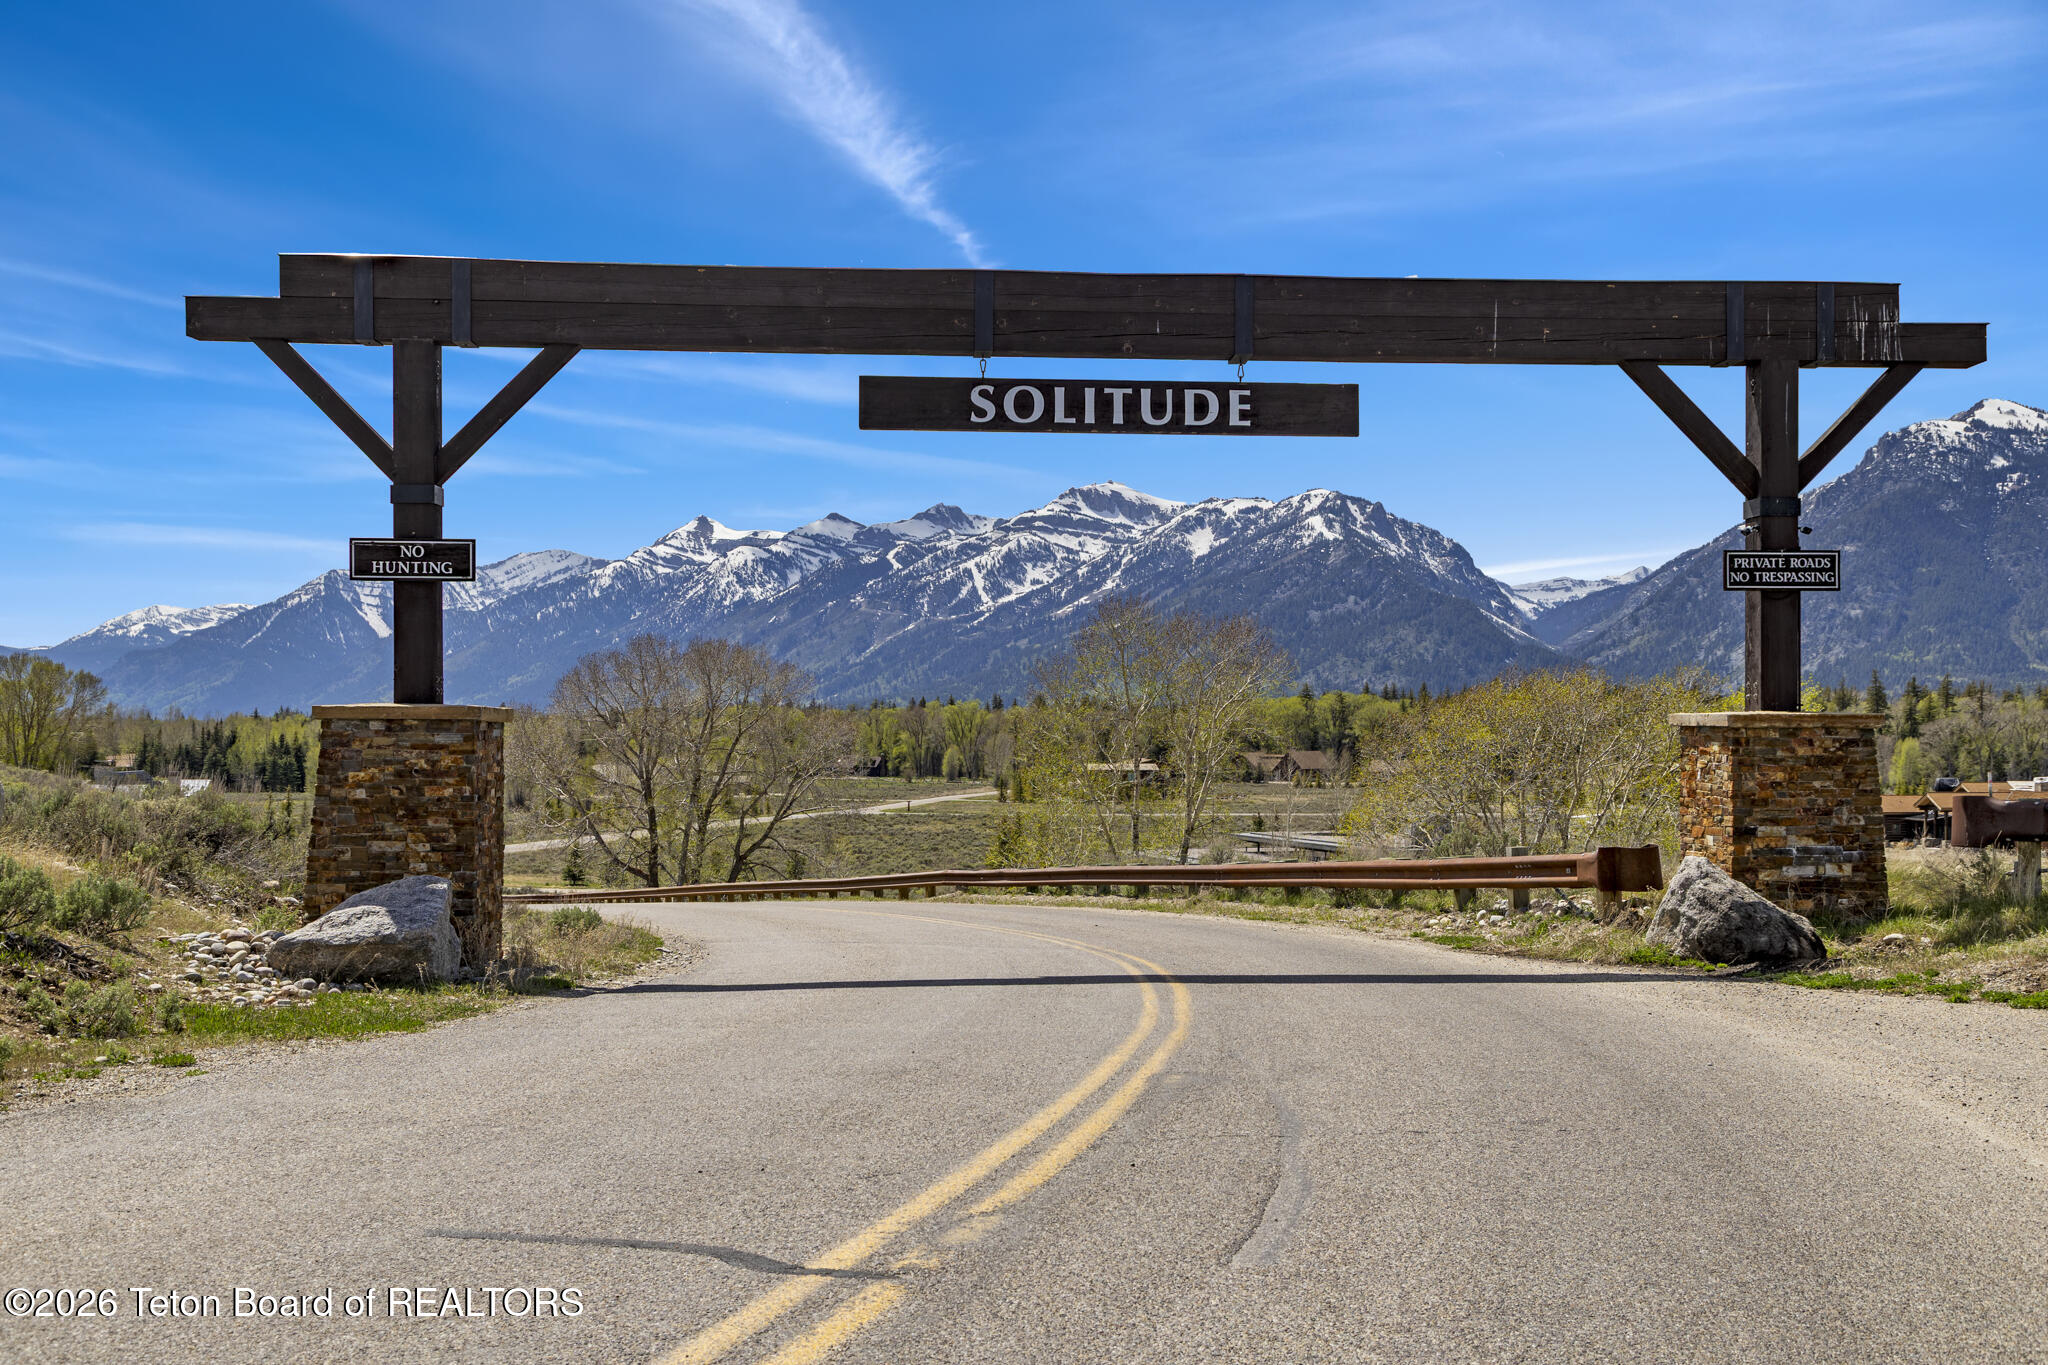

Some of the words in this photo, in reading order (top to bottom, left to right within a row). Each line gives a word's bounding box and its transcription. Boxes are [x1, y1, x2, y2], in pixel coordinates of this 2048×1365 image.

[970, 384, 1252, 428] SOLITUDE
[400, 545, 425, 558] NO
[371, 560, 453, 574] HUNTING
[1733, 557, 1786, 569] PRIVATE
[1790, 557, 1831, 569] ROADS
[1730, 571, 1750, 583] NO
[1754, 571, 1835, 583] TRESPASSING
